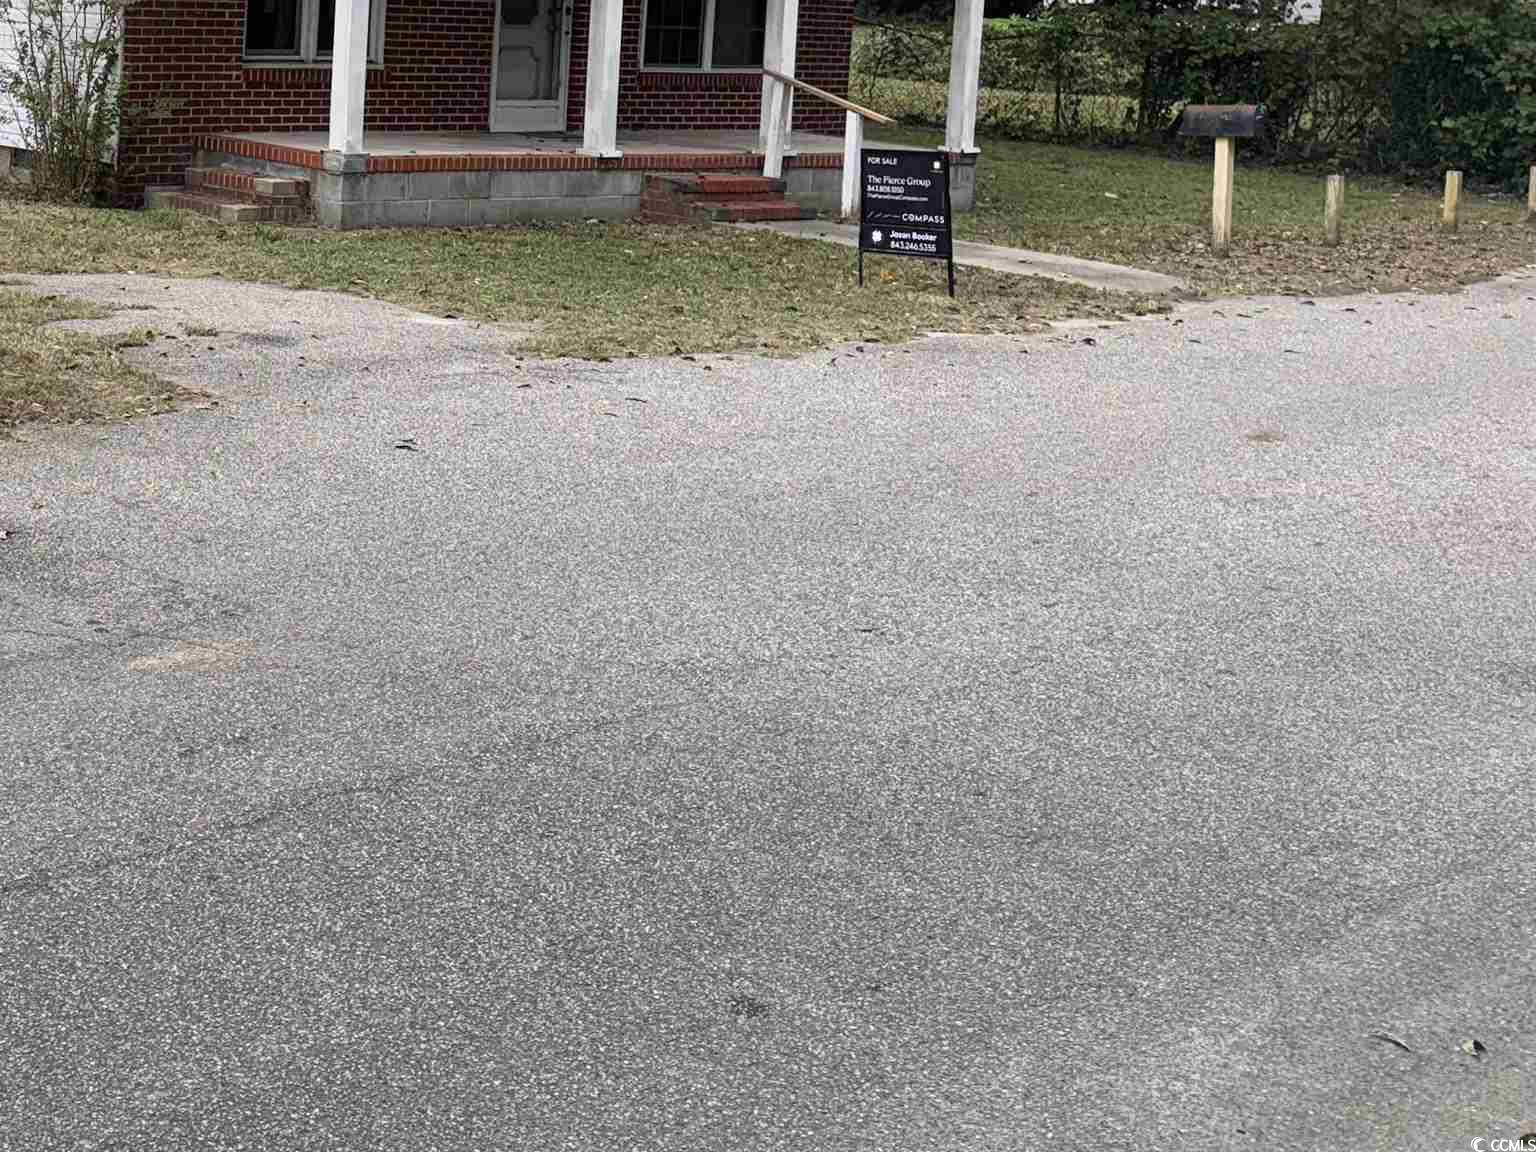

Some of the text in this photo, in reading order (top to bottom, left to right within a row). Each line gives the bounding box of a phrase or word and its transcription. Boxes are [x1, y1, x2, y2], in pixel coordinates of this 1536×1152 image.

[882, 157, 897, 165] SALE
[867, 175, 931, 187] The Pierce Group
[902, 213, 945, 224] COMPASS
[889, 230, 911, 240] Jason
